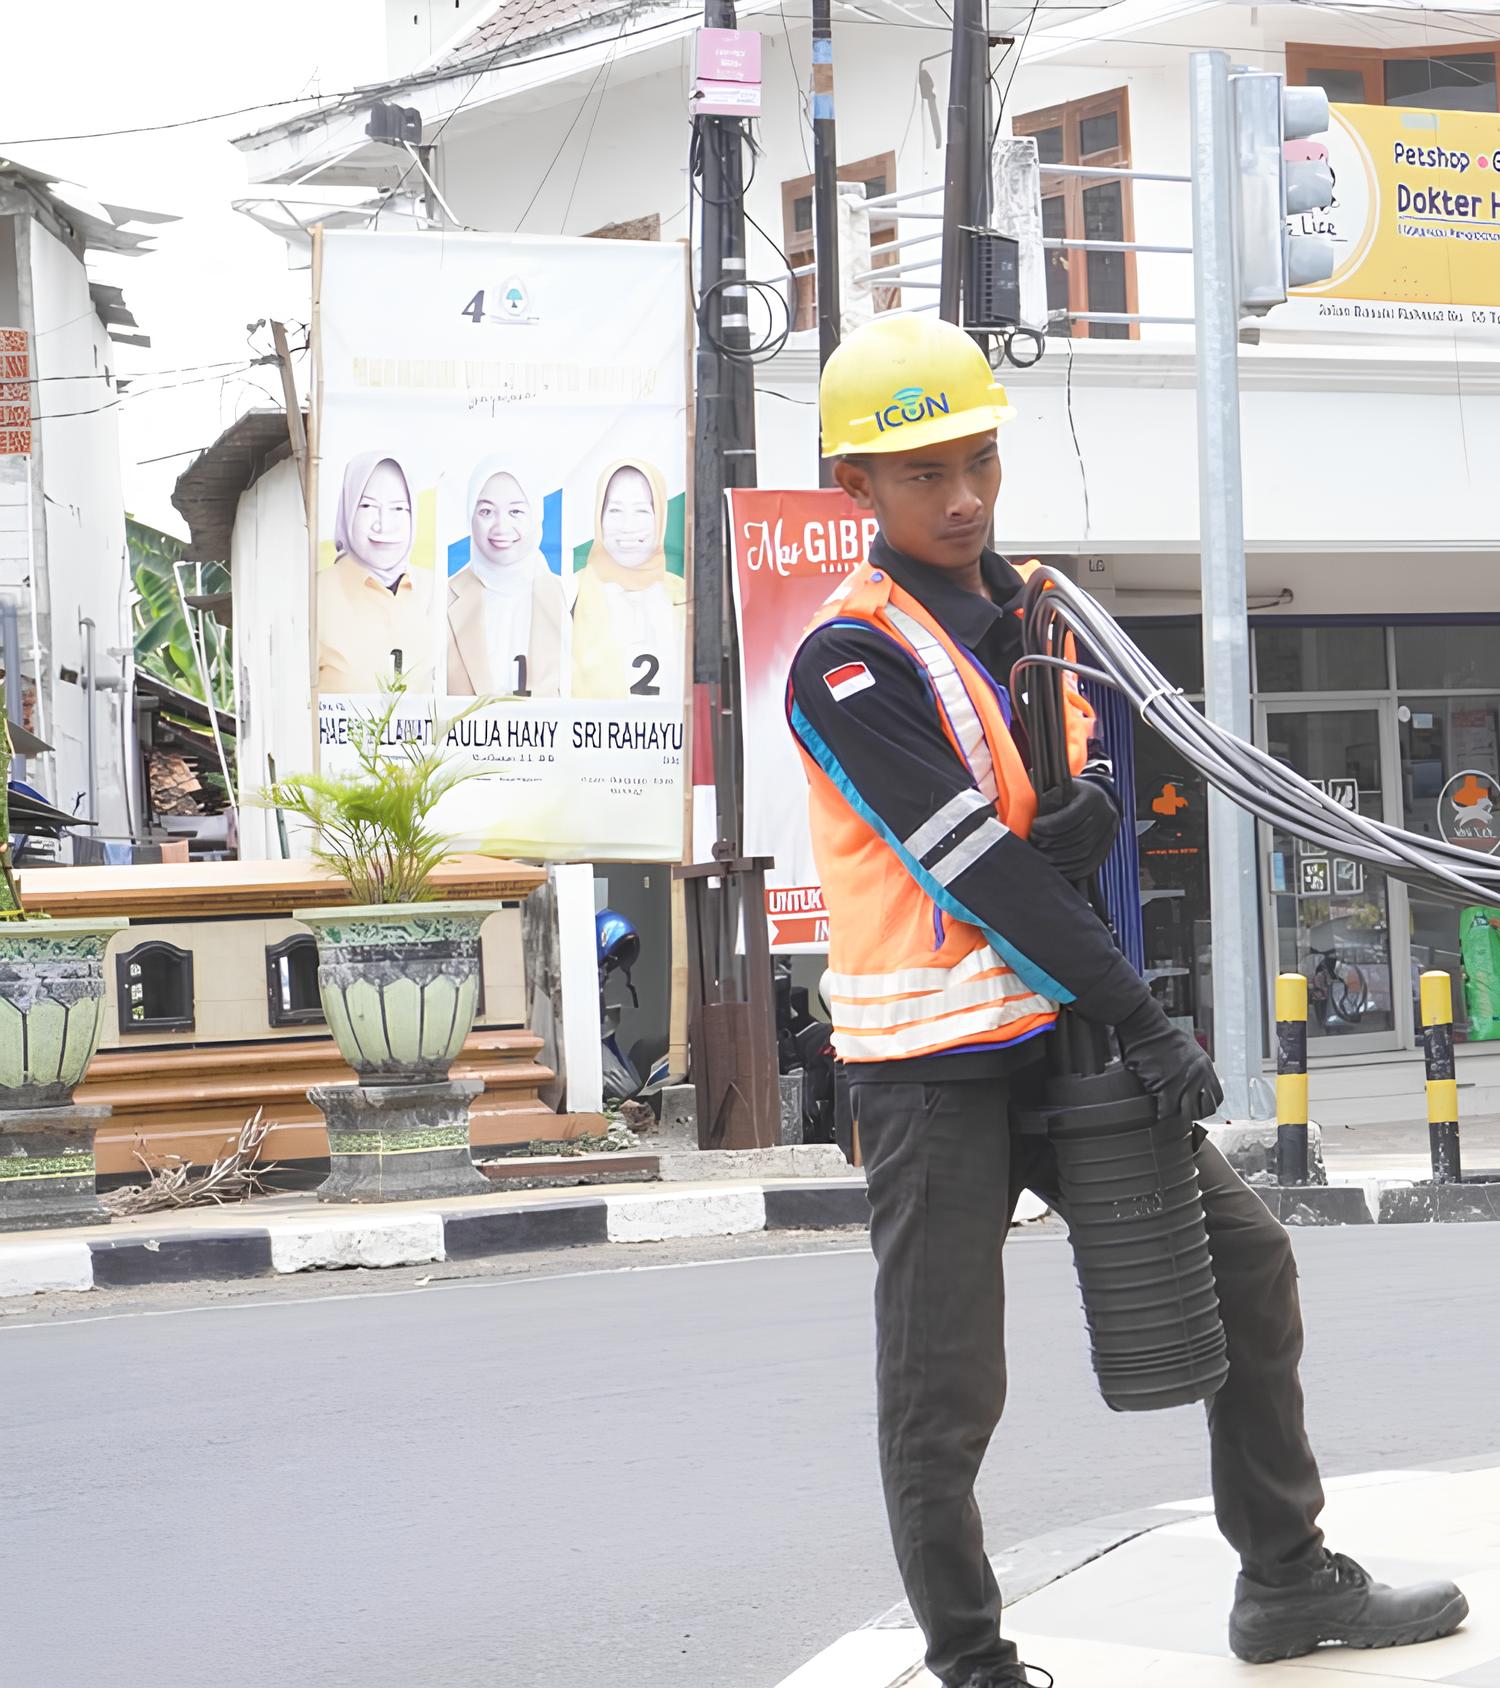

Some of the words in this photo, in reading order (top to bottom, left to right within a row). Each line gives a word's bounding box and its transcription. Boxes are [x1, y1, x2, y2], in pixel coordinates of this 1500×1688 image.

[1394, 142, 1470, 173] Petshop
[1397, 183, 1482, 217] Dokter
[461, 289, 486, 323] 4
[875, 391, 950, 432] ICON
[512, 654, 532, 697] 1
[629, 653, 660, 696] 2
[446, 719, 502, 748] AULIA
[507, 720, 558, 748] HANY
[572, 721, 602, 749] SRI
[608, 721, 683, 750] RAHAYU
[768, 888, 823, 913] UNTUK
